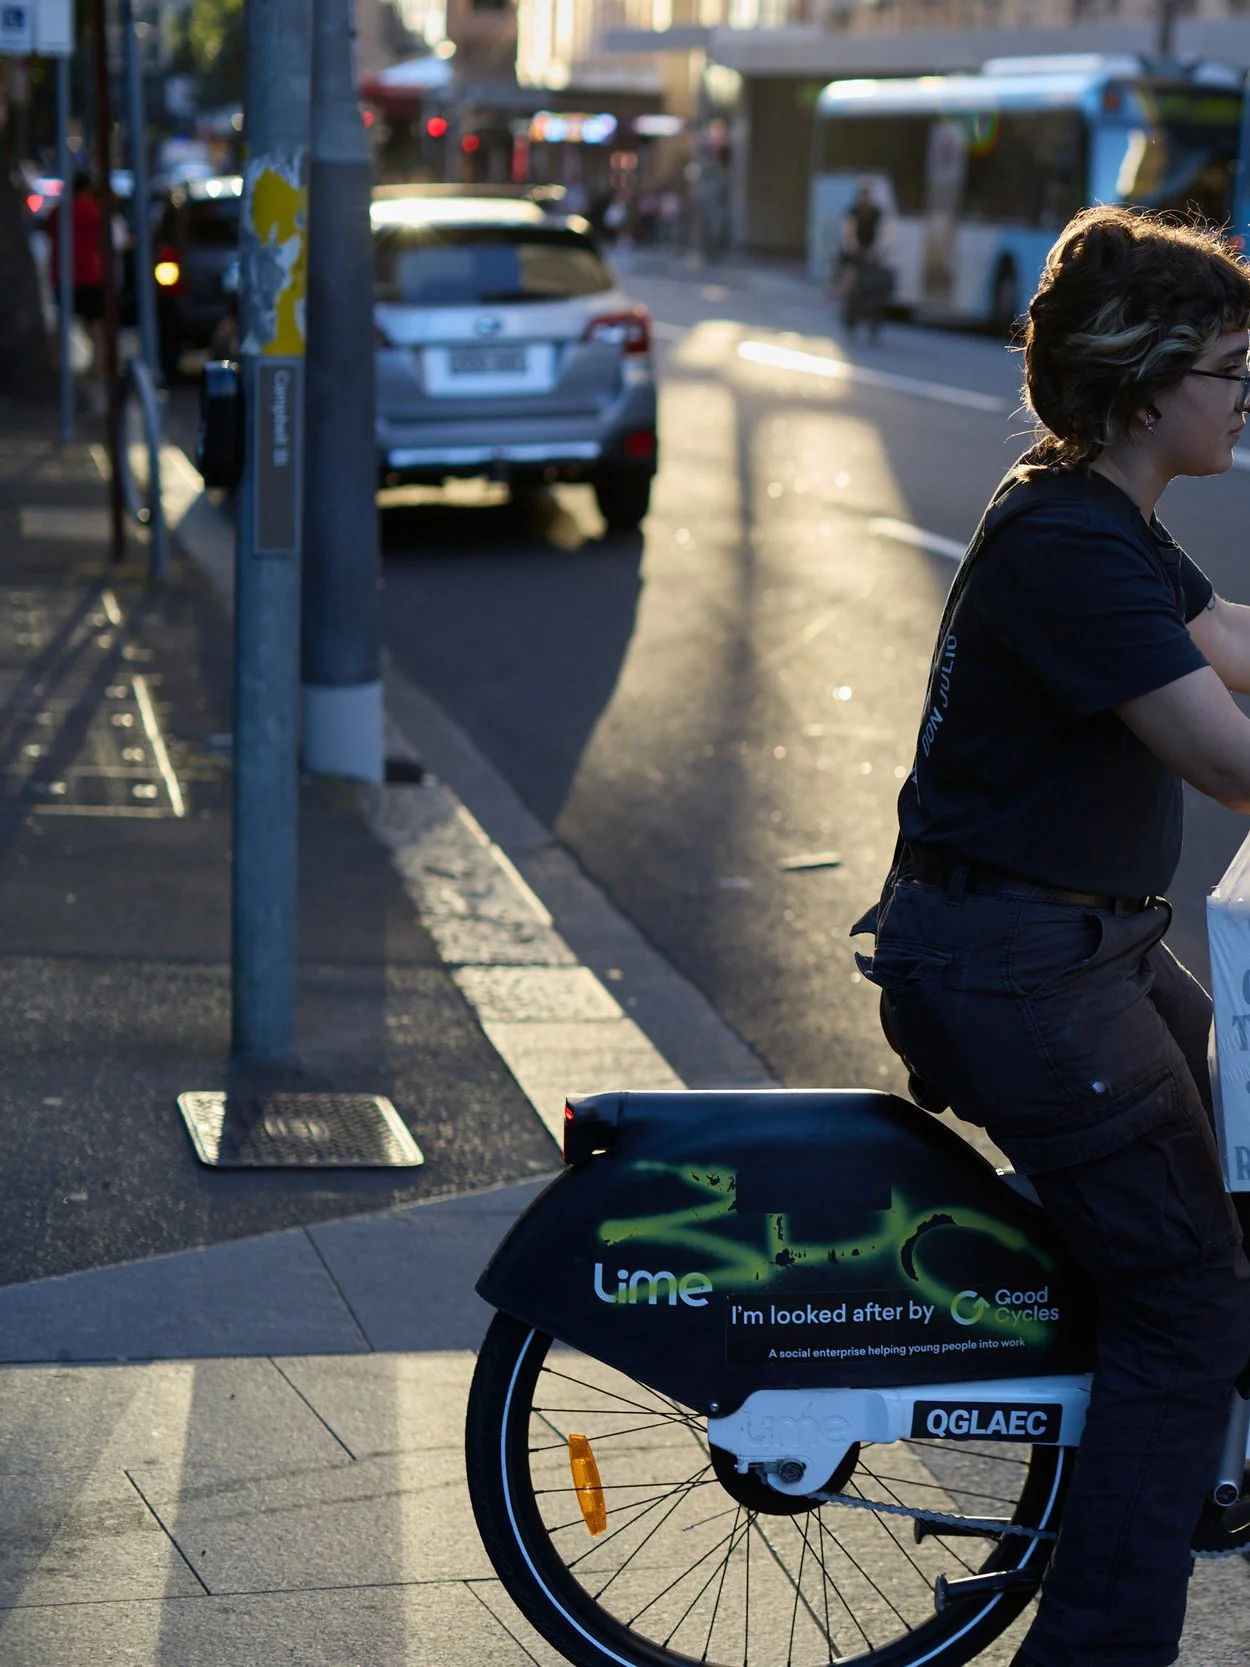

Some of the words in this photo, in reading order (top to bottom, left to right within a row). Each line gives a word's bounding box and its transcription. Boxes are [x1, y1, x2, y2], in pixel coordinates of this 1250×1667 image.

[921, 706, 944, 757] DON
[938, 634, 957, 708] JULIO
[594, 1262, 713, 1307] Lime
[995, 1286, 1049, 1305] Good
[731, 1305, 764, 1325] I'm
[770, 1303, 846, 1325] looked
[853, 1303, 904, 1323] after
[909, 1300, 935, 1325] by
[995, 1304, 1060, 1327] Cycles
[769, 1349, 777, 1359] A
[779, 1347, 810, 1359] social
[813, 1347, 866, 1361] enterprise
[868, 1343, 906, 1358] helping
[908, 1342, 941, 1356] young
[942, 1339, 977, 1353] people
[979, 1338, 999, 1350] into
[1001, 1337, 1026, 1348] work
[926, 1409, 1048, 1437] QGLAEC
